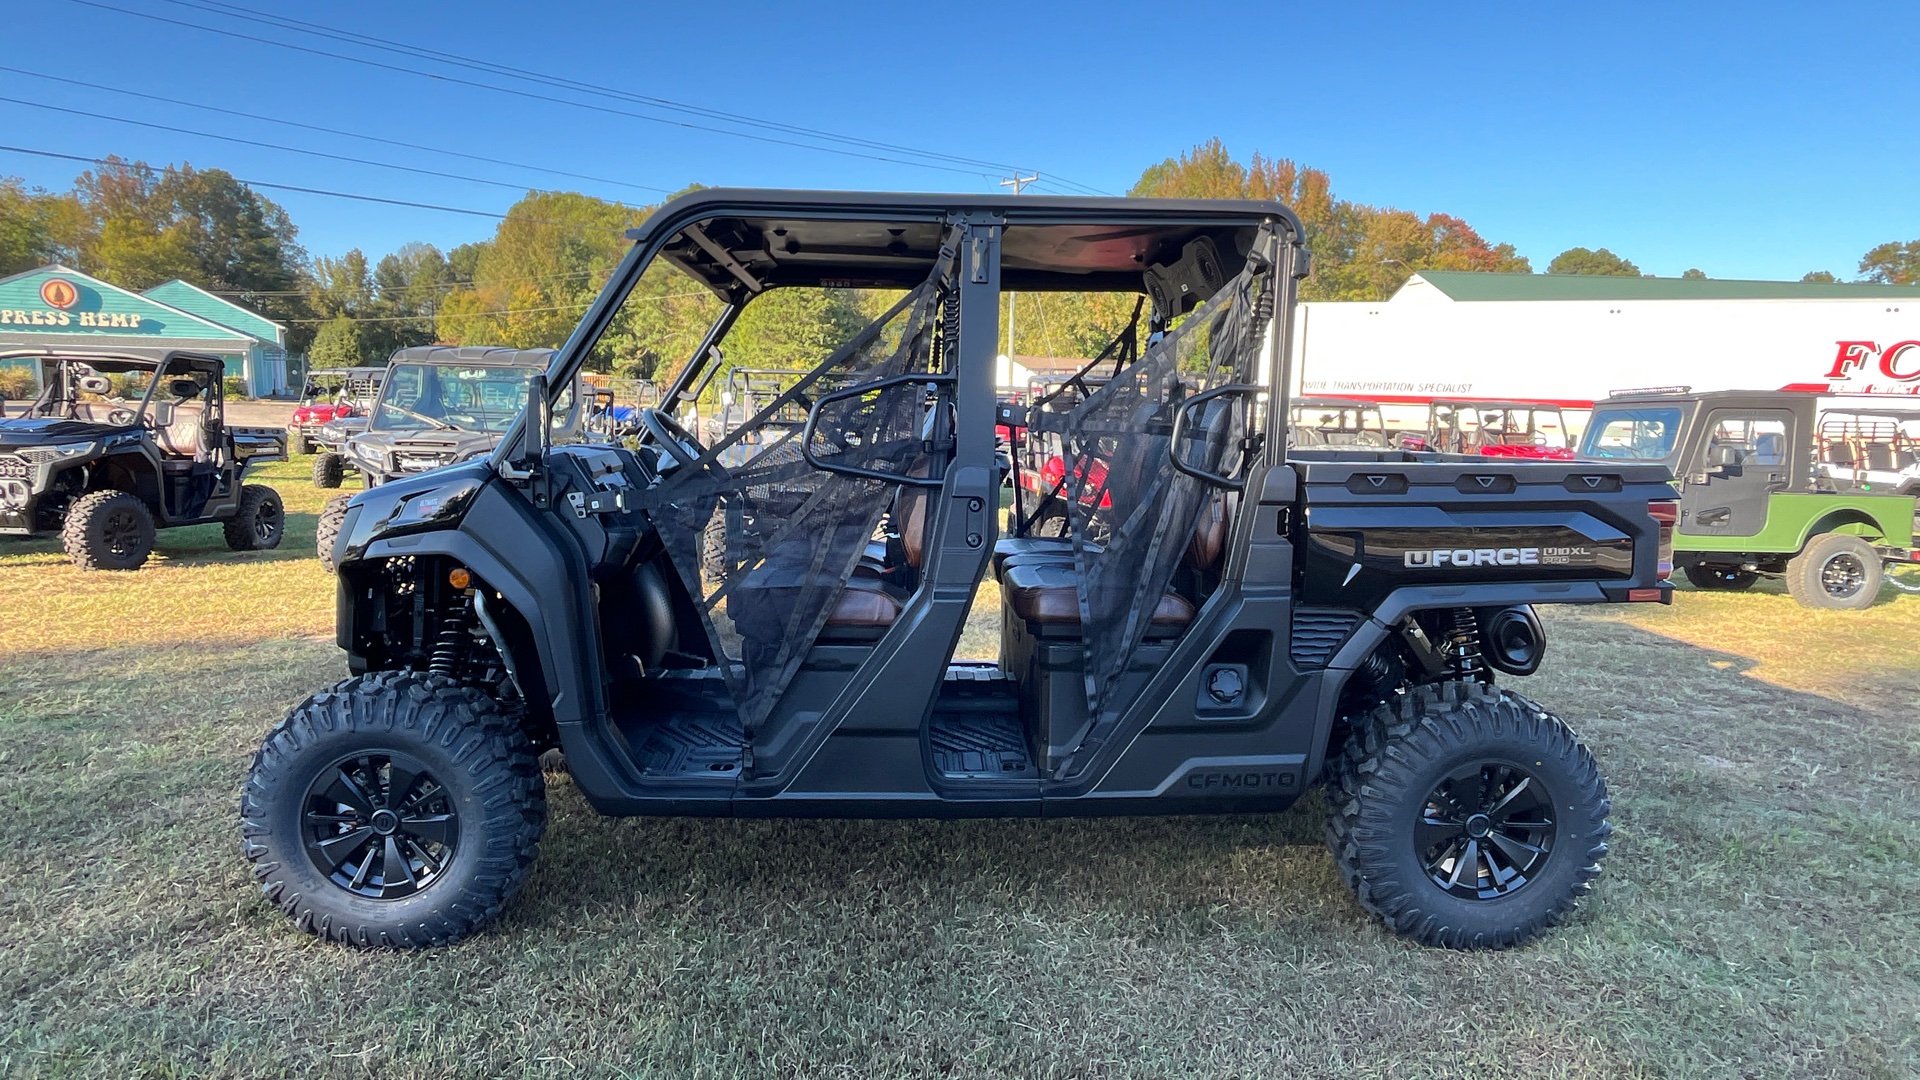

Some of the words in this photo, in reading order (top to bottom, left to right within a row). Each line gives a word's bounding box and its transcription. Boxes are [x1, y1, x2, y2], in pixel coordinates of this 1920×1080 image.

[1, 309, 71, 326] PRESS
[79, 312, 141, 328] HEMP
[1333, 381, 1414, 392] TRANSPORTATION
[1418, 382, 1473, 393] SPECIALIST
[1404, 547, 1540, 568] UFORCE
[1542, 556, 1570, 565] PRO
[1187, 772, 1296, 789] CFMOTO
